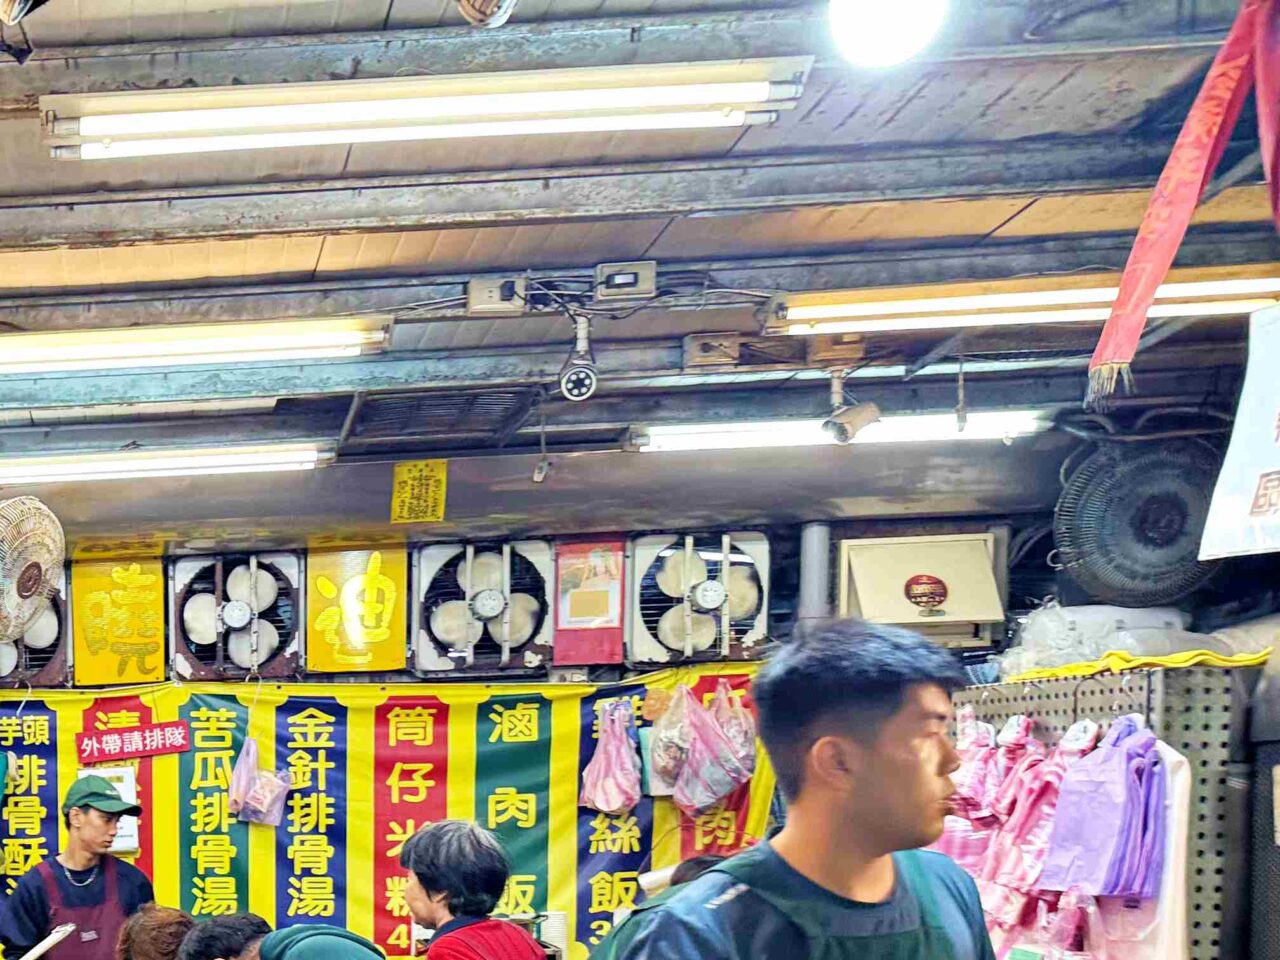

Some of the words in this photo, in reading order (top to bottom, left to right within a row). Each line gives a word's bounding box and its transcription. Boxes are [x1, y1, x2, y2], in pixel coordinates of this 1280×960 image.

[80, 725, 188, 758] 外帶請排隊
[189, 707, 239, 917] 苦瓜排骨湯
[286, 707, 336, 917] 金針排骨湯
